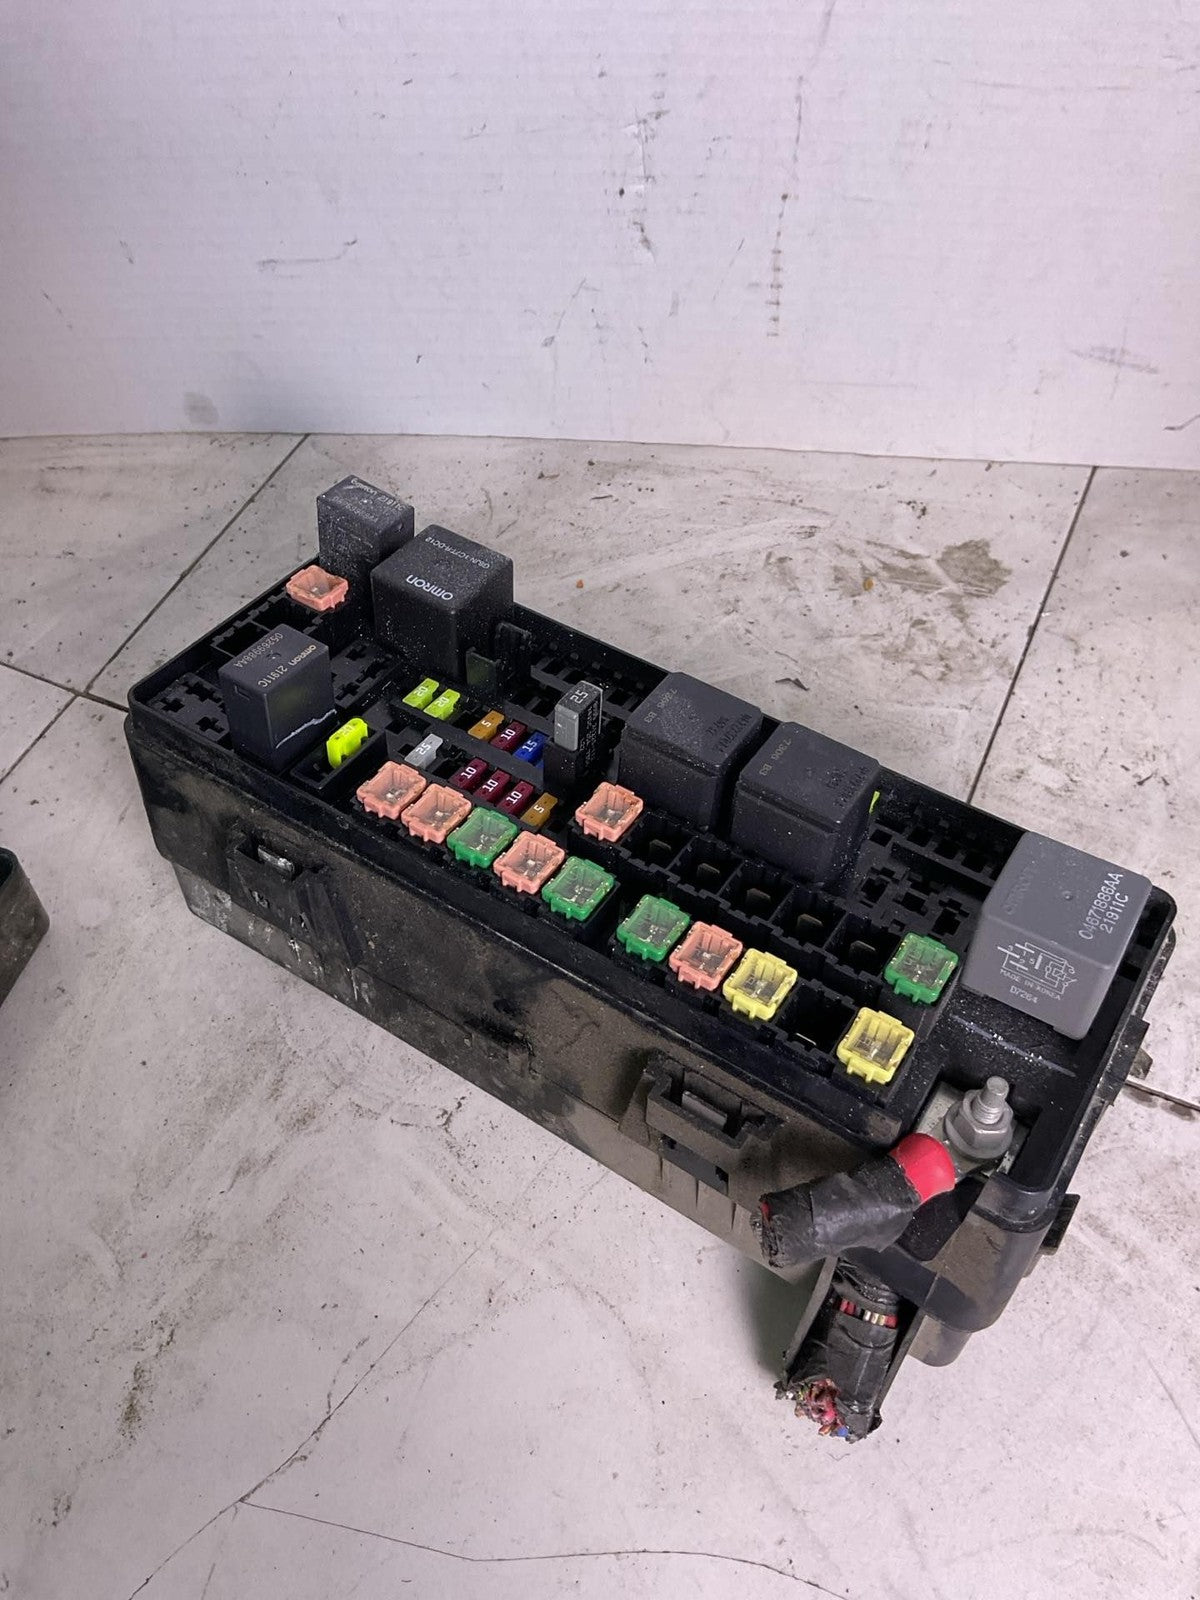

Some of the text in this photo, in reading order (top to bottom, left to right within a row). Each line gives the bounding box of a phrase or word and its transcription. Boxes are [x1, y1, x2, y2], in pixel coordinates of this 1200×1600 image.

[257, 665, 288, 687] 21911C
[413, 686, 428, 697] 20
[569, 689, 589, 704] 25
[434, 697, 450, 708] 20
[481, 720, 491, 728] 5
[501, 729, 516, 741] 10
[415, 743, 431, 755] 25
[522, 739, 539, 754] 15
[461, 766, 477, 779] 10
[482, 780, 499, 793] 10
[506, 791, 523, 805] 10
[533, 805, 545, 813] 5
[1078, 873, 1124, 940] 04671886AA
[1099, 892, 1129, 934] 21911C
[1000, 969, 1061, 1000] MADE IN KOREA
